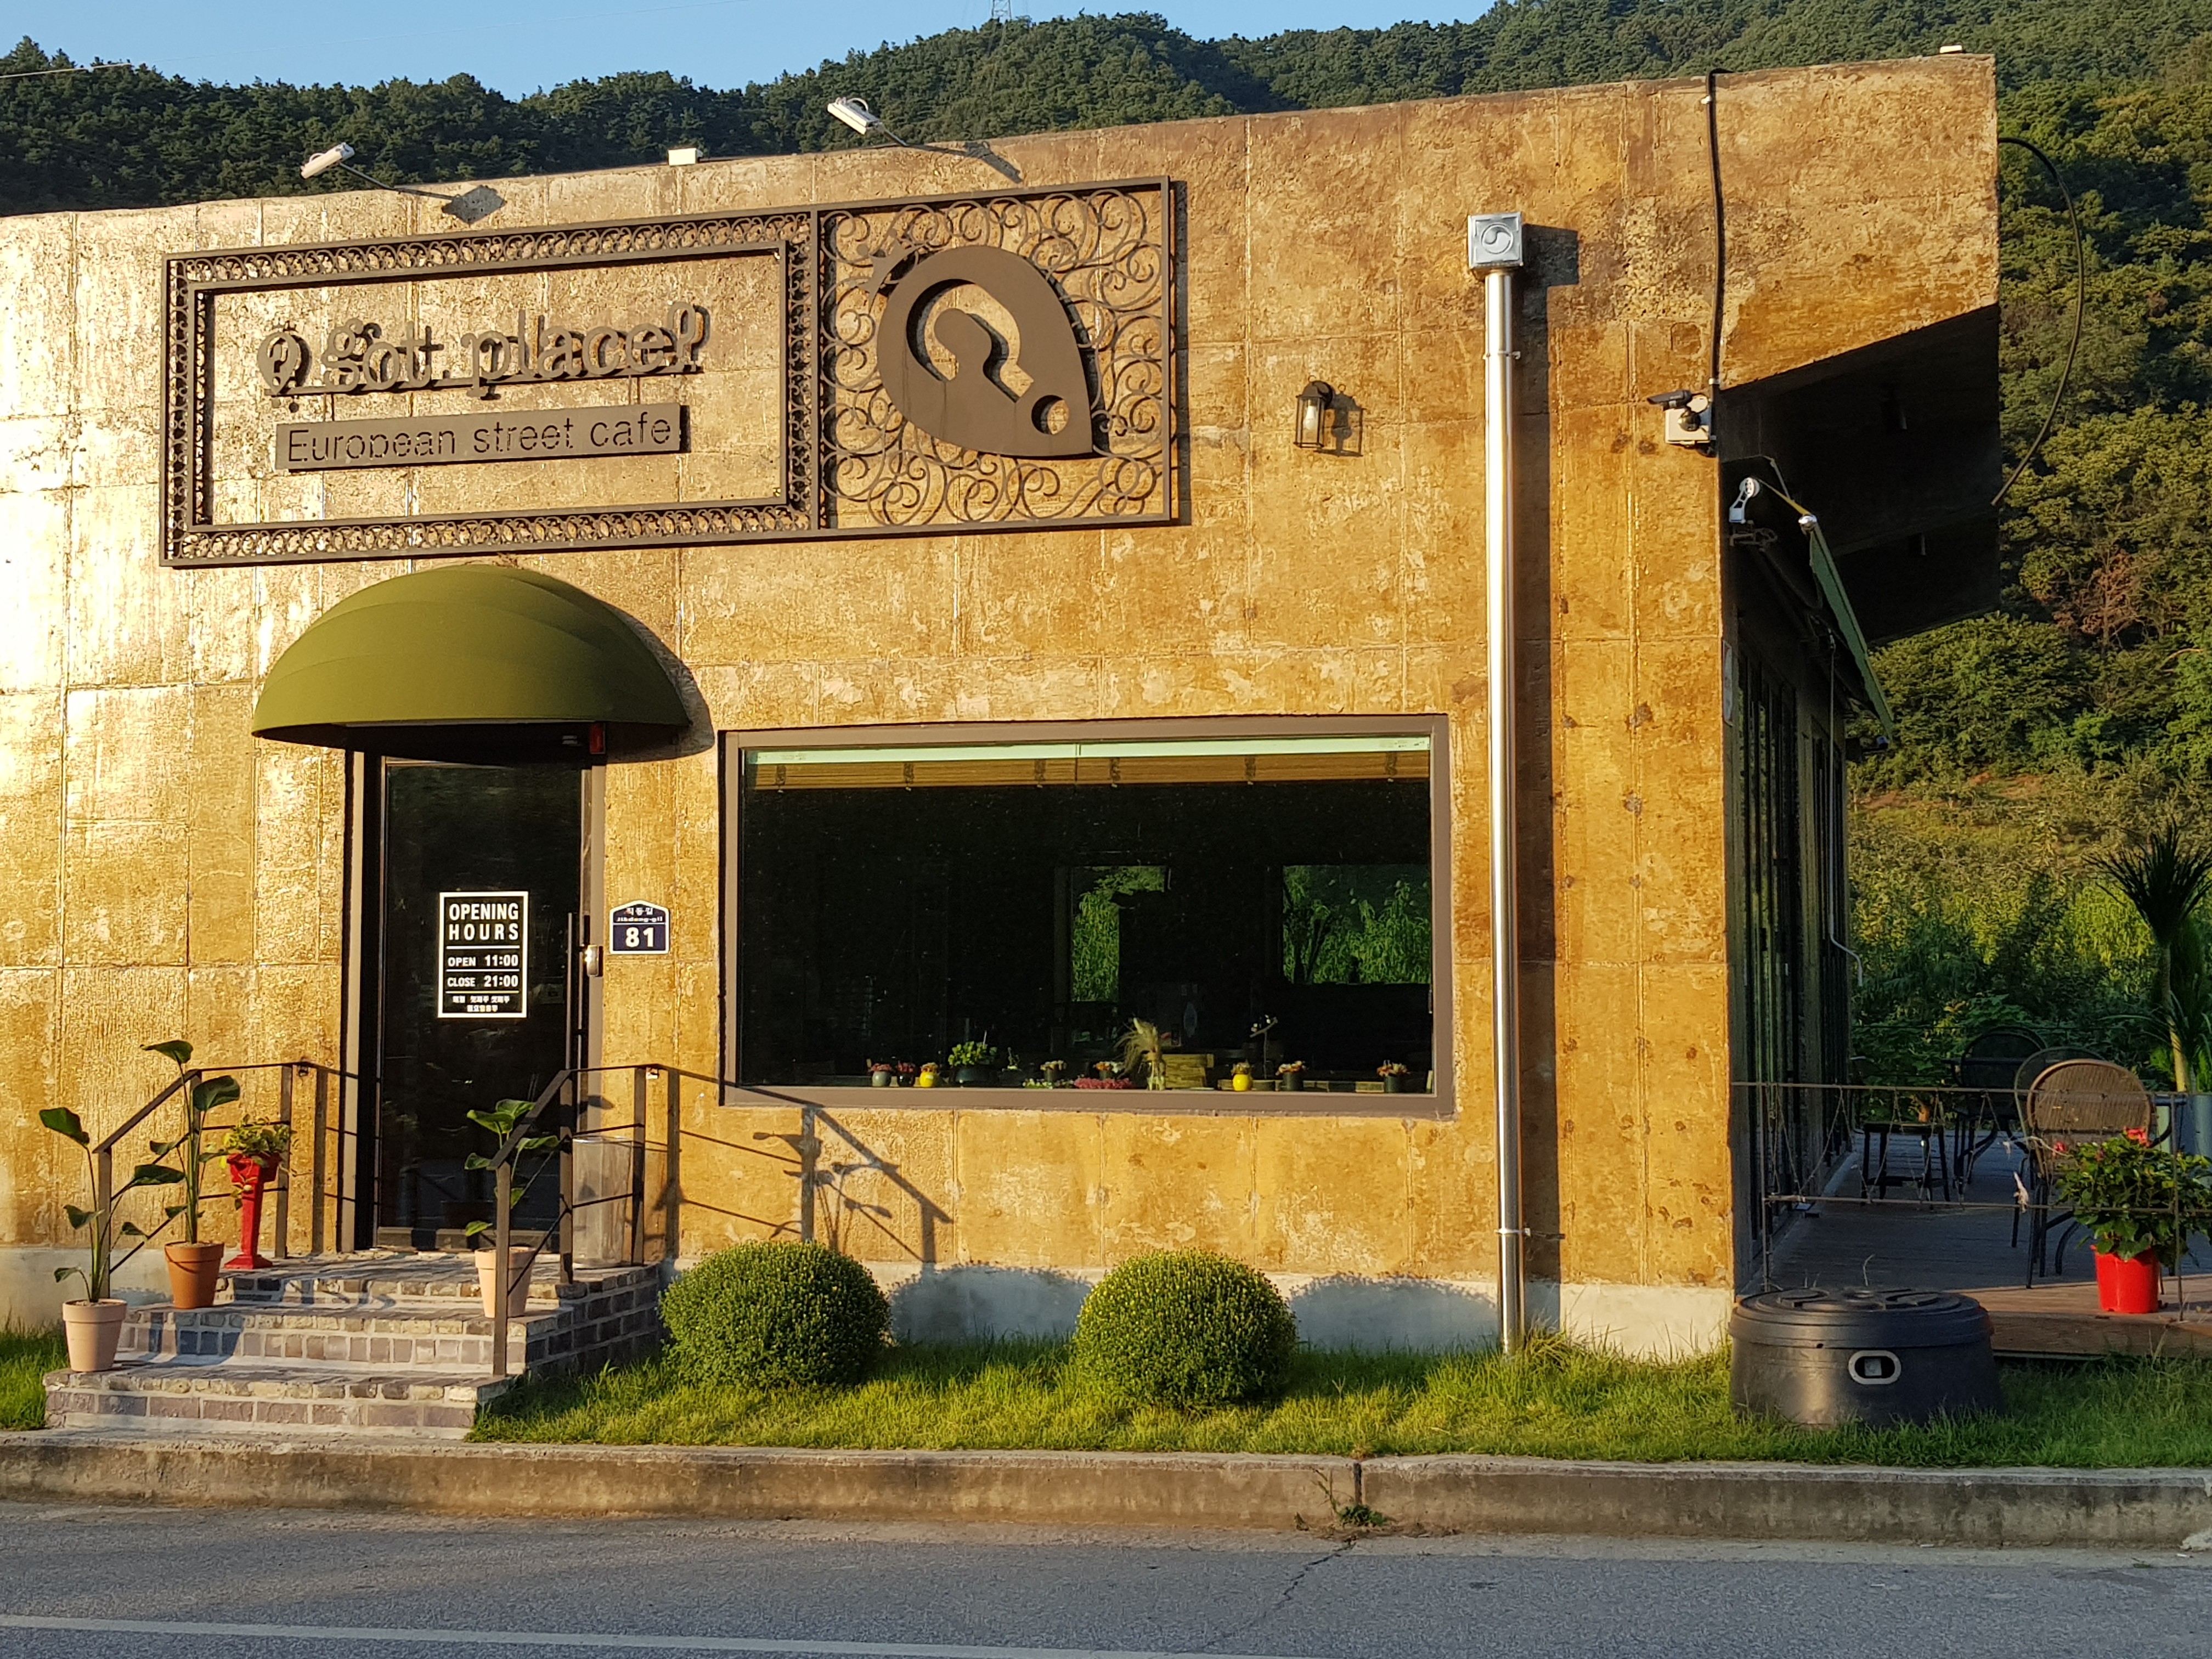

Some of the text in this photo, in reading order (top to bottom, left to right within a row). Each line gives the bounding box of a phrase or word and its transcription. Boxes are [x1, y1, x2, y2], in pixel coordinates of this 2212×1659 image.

[288, 411, 671, 462] European street cafe
[449, 903, 519, 921] OPENING
[449, 923, 519, 940] HOURS
[625, 927, 654, 948] 81
[448, 955, 519, 967] OPEN 11:00
[447, 975, 519, 988] CLOSE 21:00
